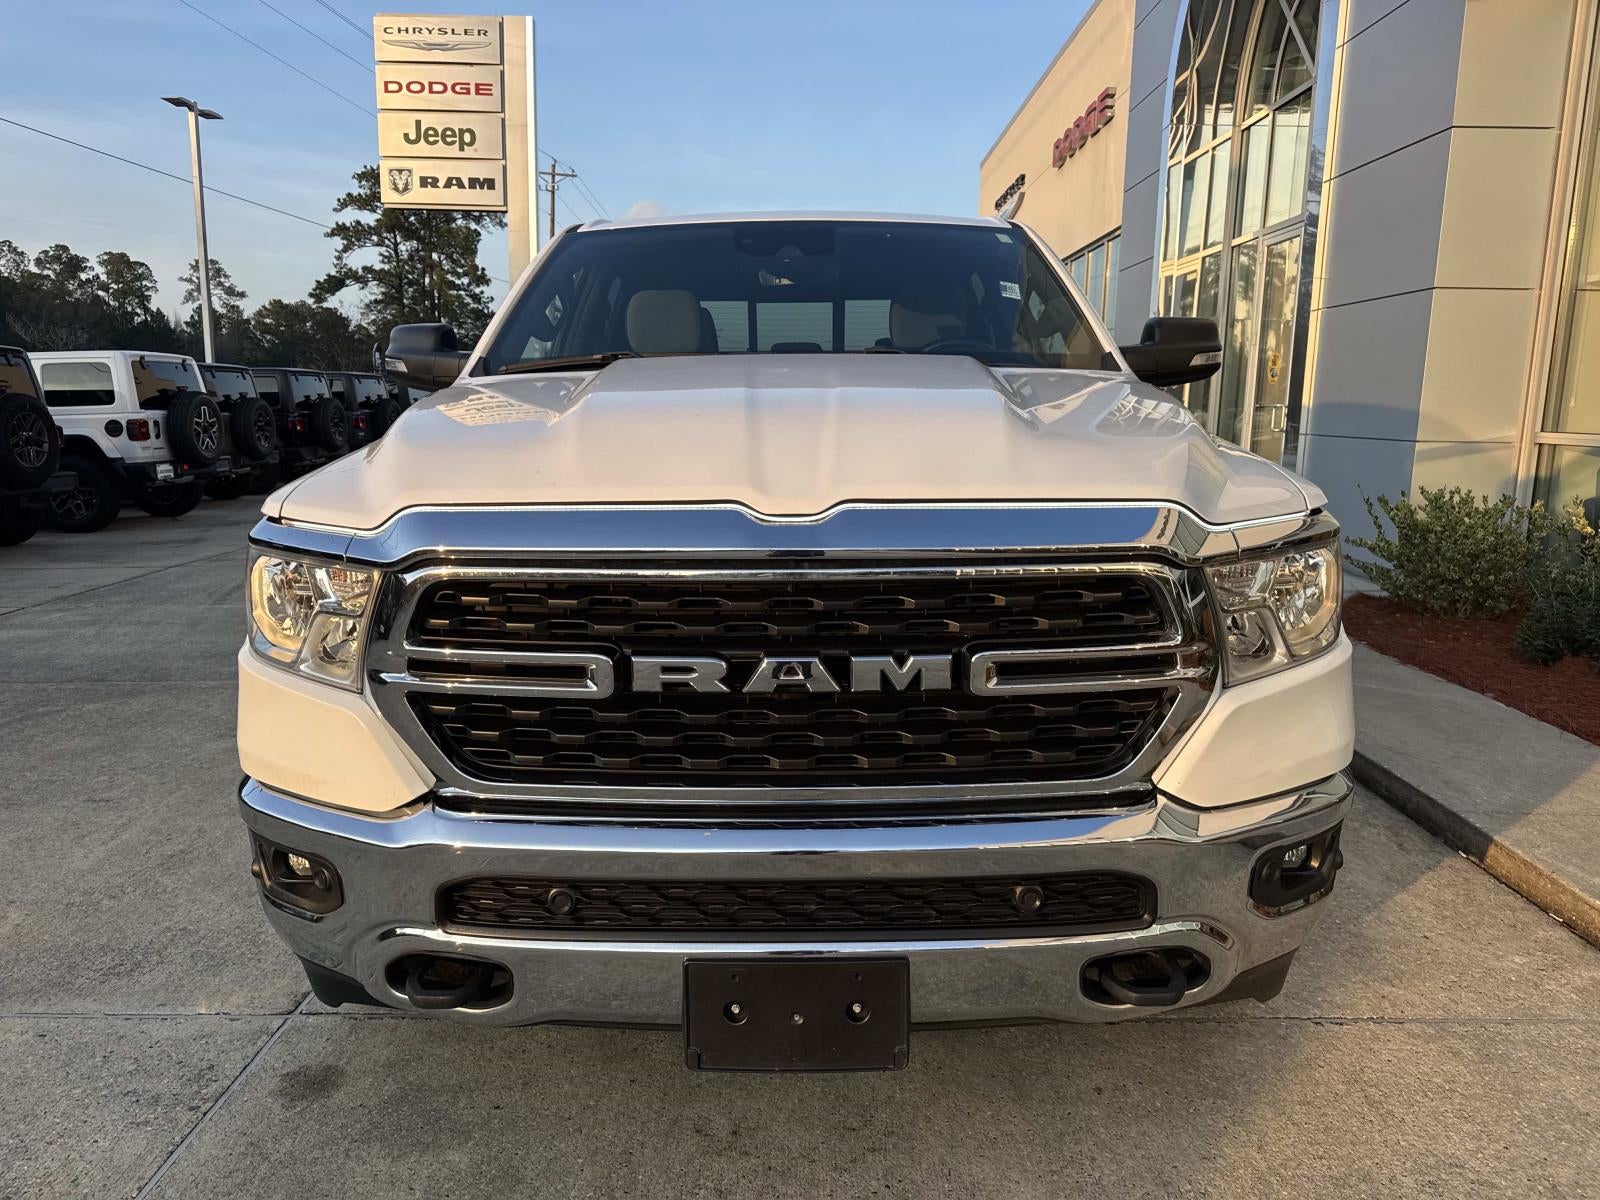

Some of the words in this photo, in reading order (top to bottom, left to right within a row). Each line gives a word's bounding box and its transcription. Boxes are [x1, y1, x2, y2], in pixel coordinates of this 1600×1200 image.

[383, 26, 489, 37] CHRYSLER
[383, 80, 494, 96] DODGE
[403, 119, 477, 152] Jeep
[1052, 86, 1117, 169] DODGE
[419, 175, 496, 191] RAM
[631, 655, 952, 693] RAM
